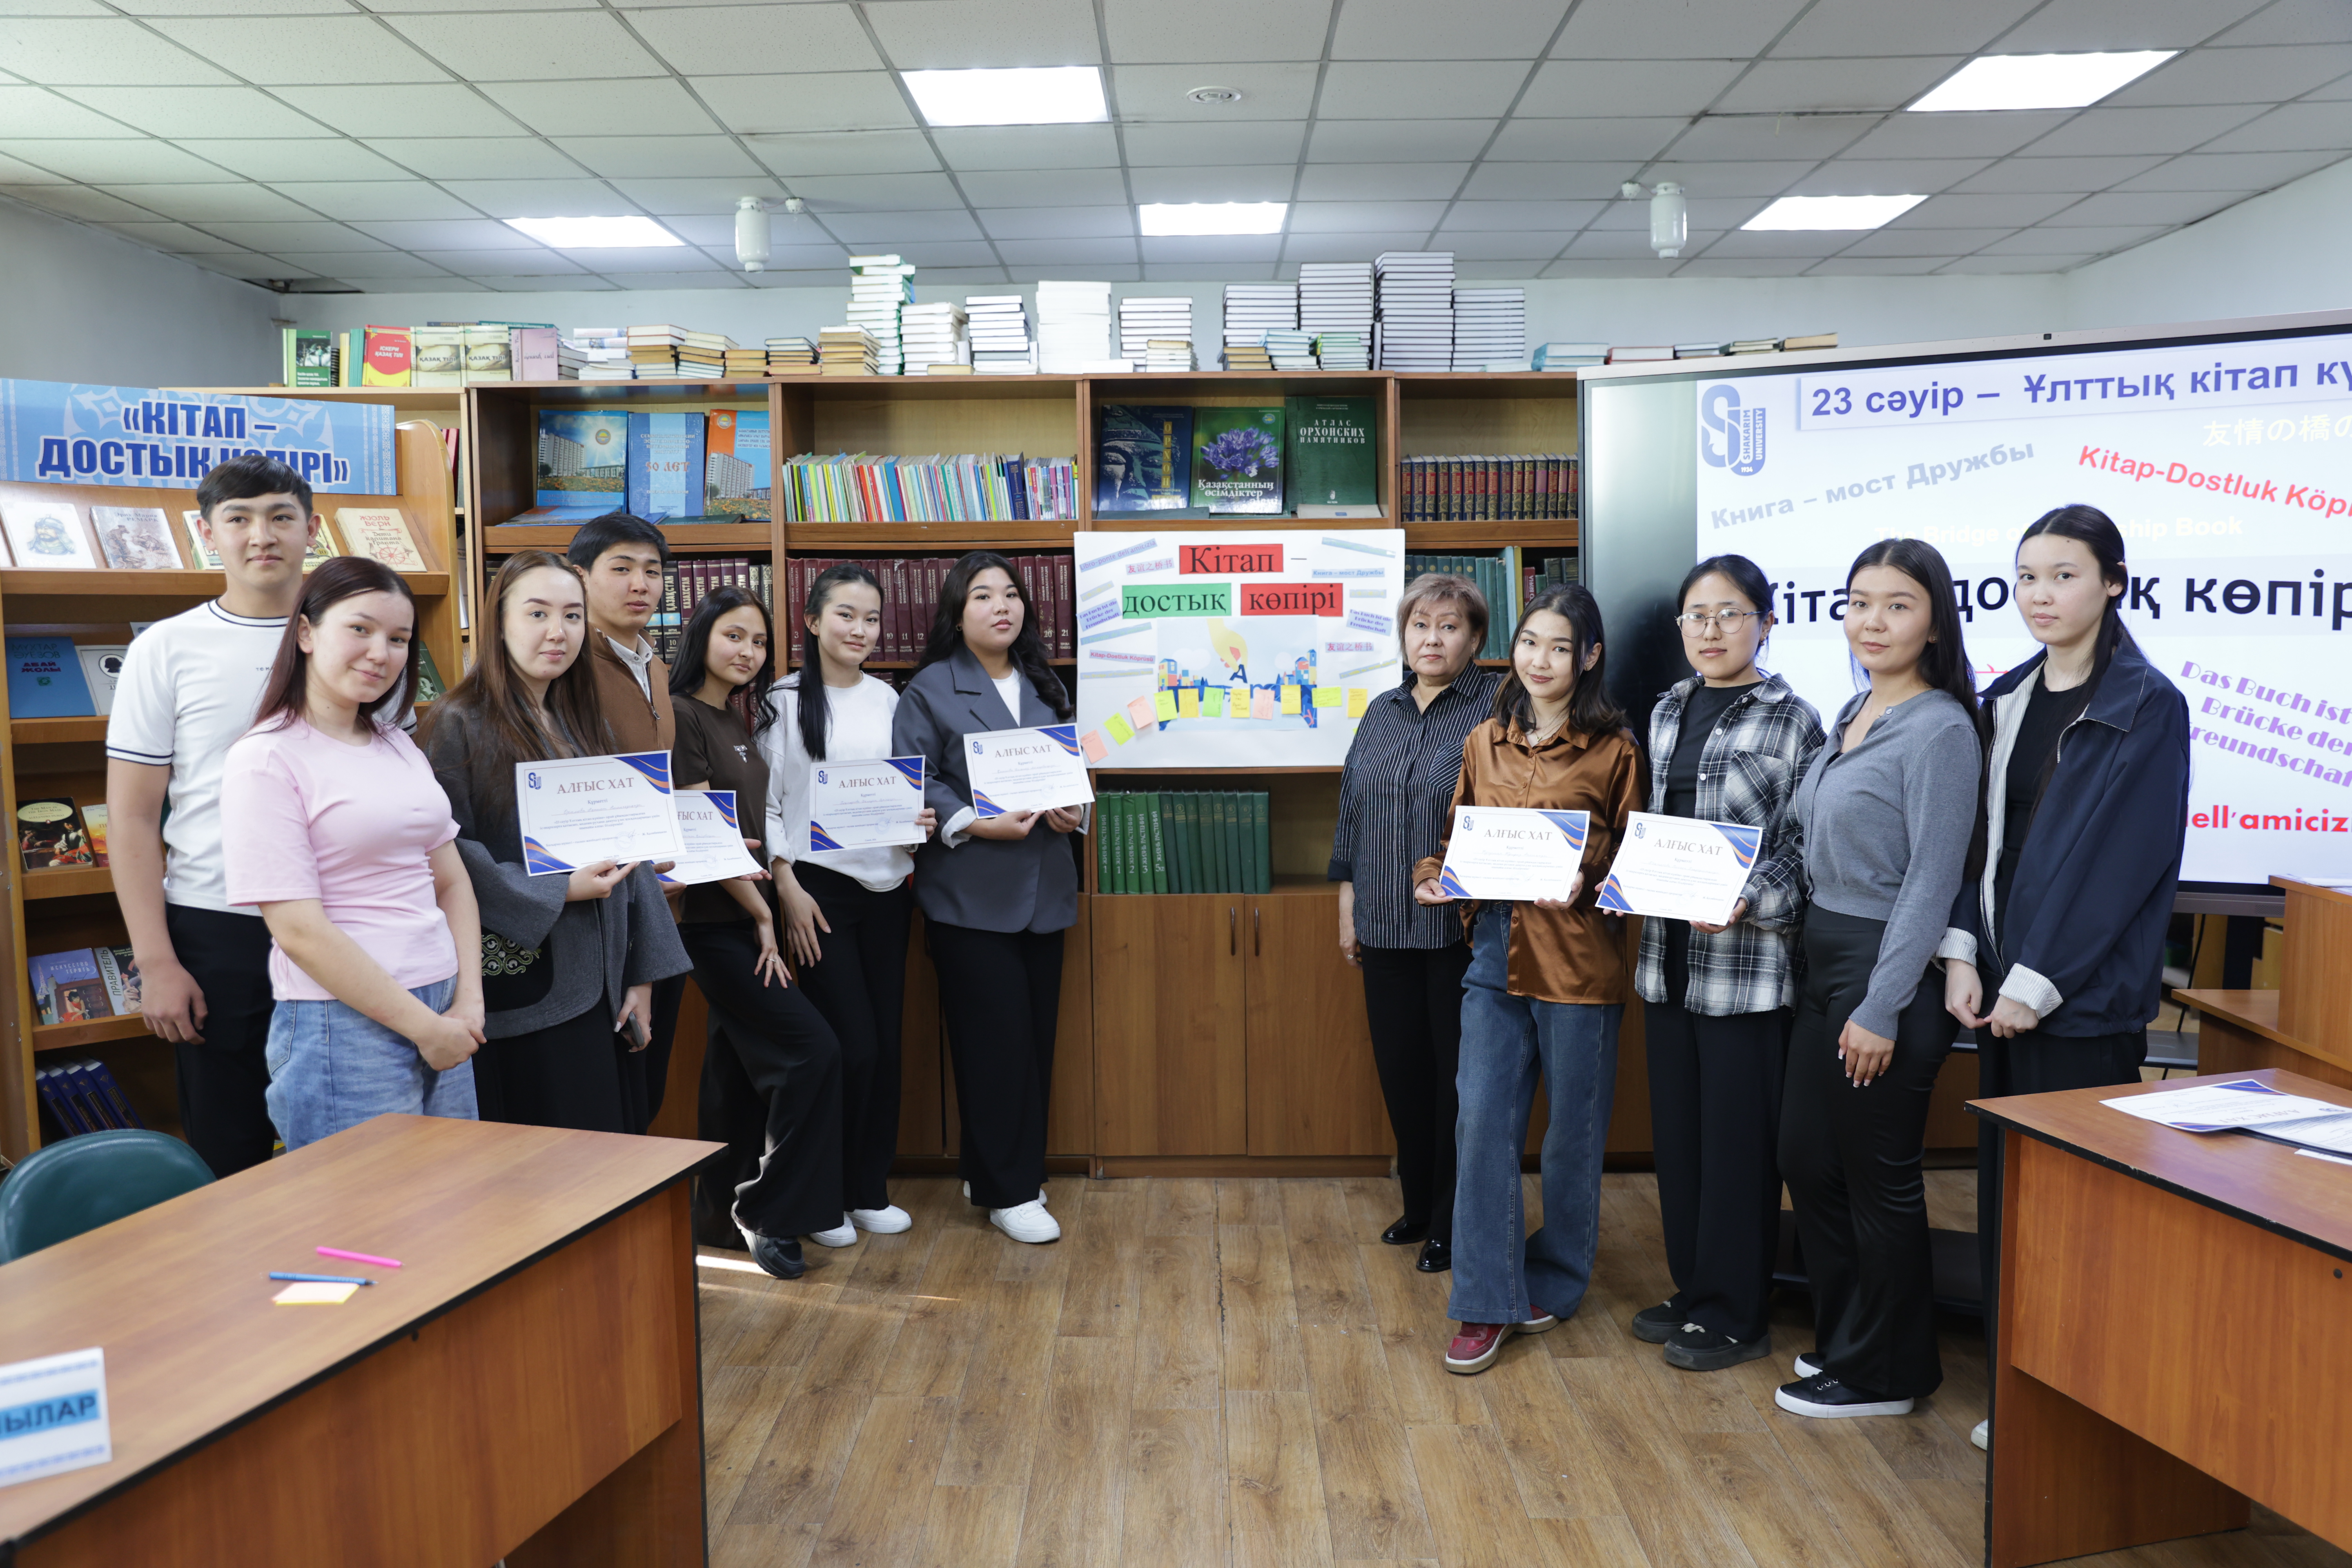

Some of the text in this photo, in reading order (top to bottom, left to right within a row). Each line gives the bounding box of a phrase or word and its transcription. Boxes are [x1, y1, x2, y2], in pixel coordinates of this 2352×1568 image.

[1812, 387, 1852, 416] 23
[1866, 381, 1964, 418] сәуір
[2024, 373, 2174, 403] Ұлттық
[2190, 362, 2298, 393] кітап
[124, 401, 246, 439] «КІТАП
[1300, 427, 1365, 437] ОРХОНСКИХ
[645, 462, 690, 472] 50 ЛЕТ
[2079, 446, 2278, 502] Kitap-Dostluk
[1198, 479, 1274, 490] Қазақстанның
[1205, 488, 1263, 499] өсімдіктер
[1711, 499, 1794, 529] Книга
[1826, 475, 1896, 503] мост
[1907, 443, 2033, 488] Дружбы
[1924, 524, 1999, 546] Bridge
[2176, 516, 2243, 537] Book
[1080, 540, 1156, 570] Libro-ponte dell'amicizia
[1189, 546, 1274, 573] Кітап
[664, 576, 677, 611] ҚАЗАҚСТАН
[682, 577, 691, 608] КАЗАХСТАН
[1123, 584, 1336, 617] достық көпірі
[1327, 642, 1372, 651] 友谊之桥书
[2180, 661, 2352, 724] Das Buch ist
[2201, 697, 2303, 740] Brücke
[995, 745, 1052, 757] АЛҒЫС ХАТ
[557, 778, 634, 794] АЛҒЫС ХАТ
[839, 777, 896, 788] АЛҒЫС ХАТ
[697, 811, 713, 820] ХАТ
[1484, 829, 1552, 840] АЛҒЫС ХАТ
[1654, 838, 1723, 855] АЛҒЫС ХАТ
[50, 961, 88, 971] ИСКУССТВО
[100, 950, 122, 996] ПРАВИТЕЛЬ
[2247, 1109, 2300, 1119] АЛҒЫС
